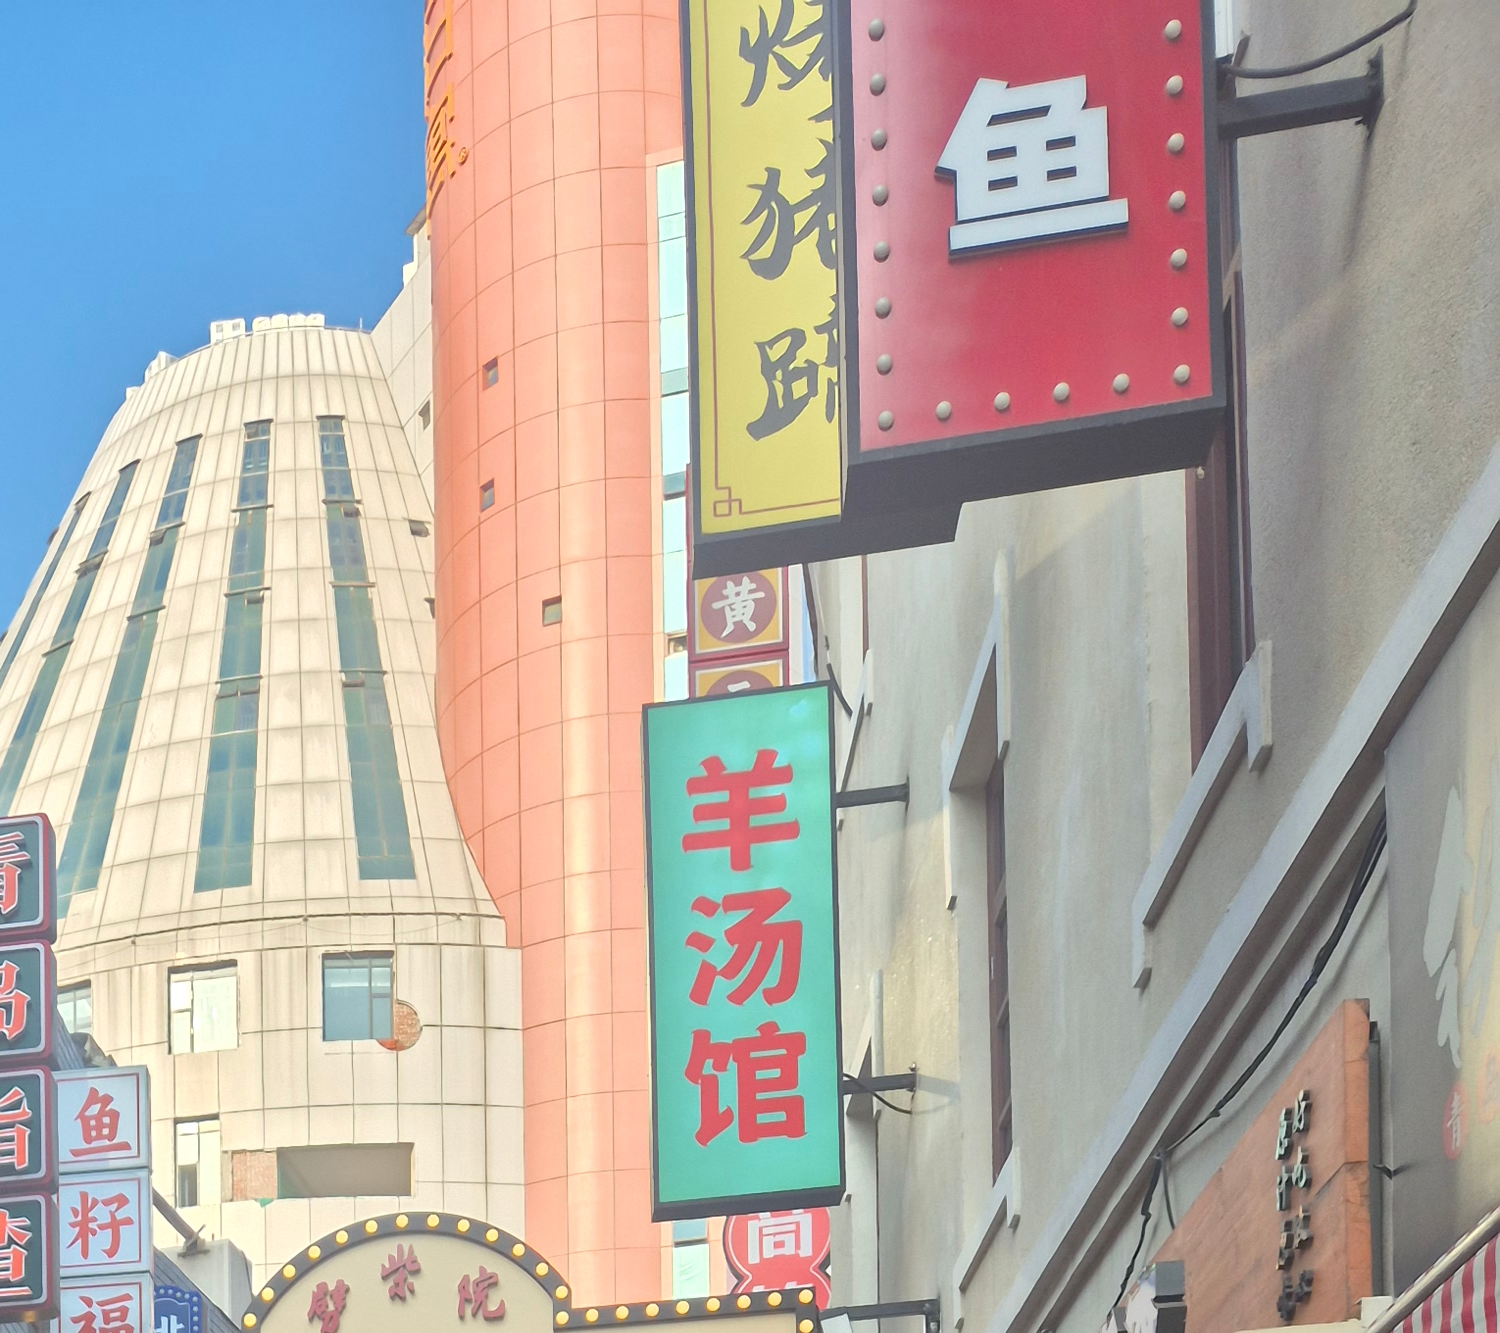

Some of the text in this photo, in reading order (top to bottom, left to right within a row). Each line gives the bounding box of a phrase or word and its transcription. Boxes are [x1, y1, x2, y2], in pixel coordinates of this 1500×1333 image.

[934, 75, 1129, 261] 鱼
[681, 749, 808, 1146] 羊汤馆
